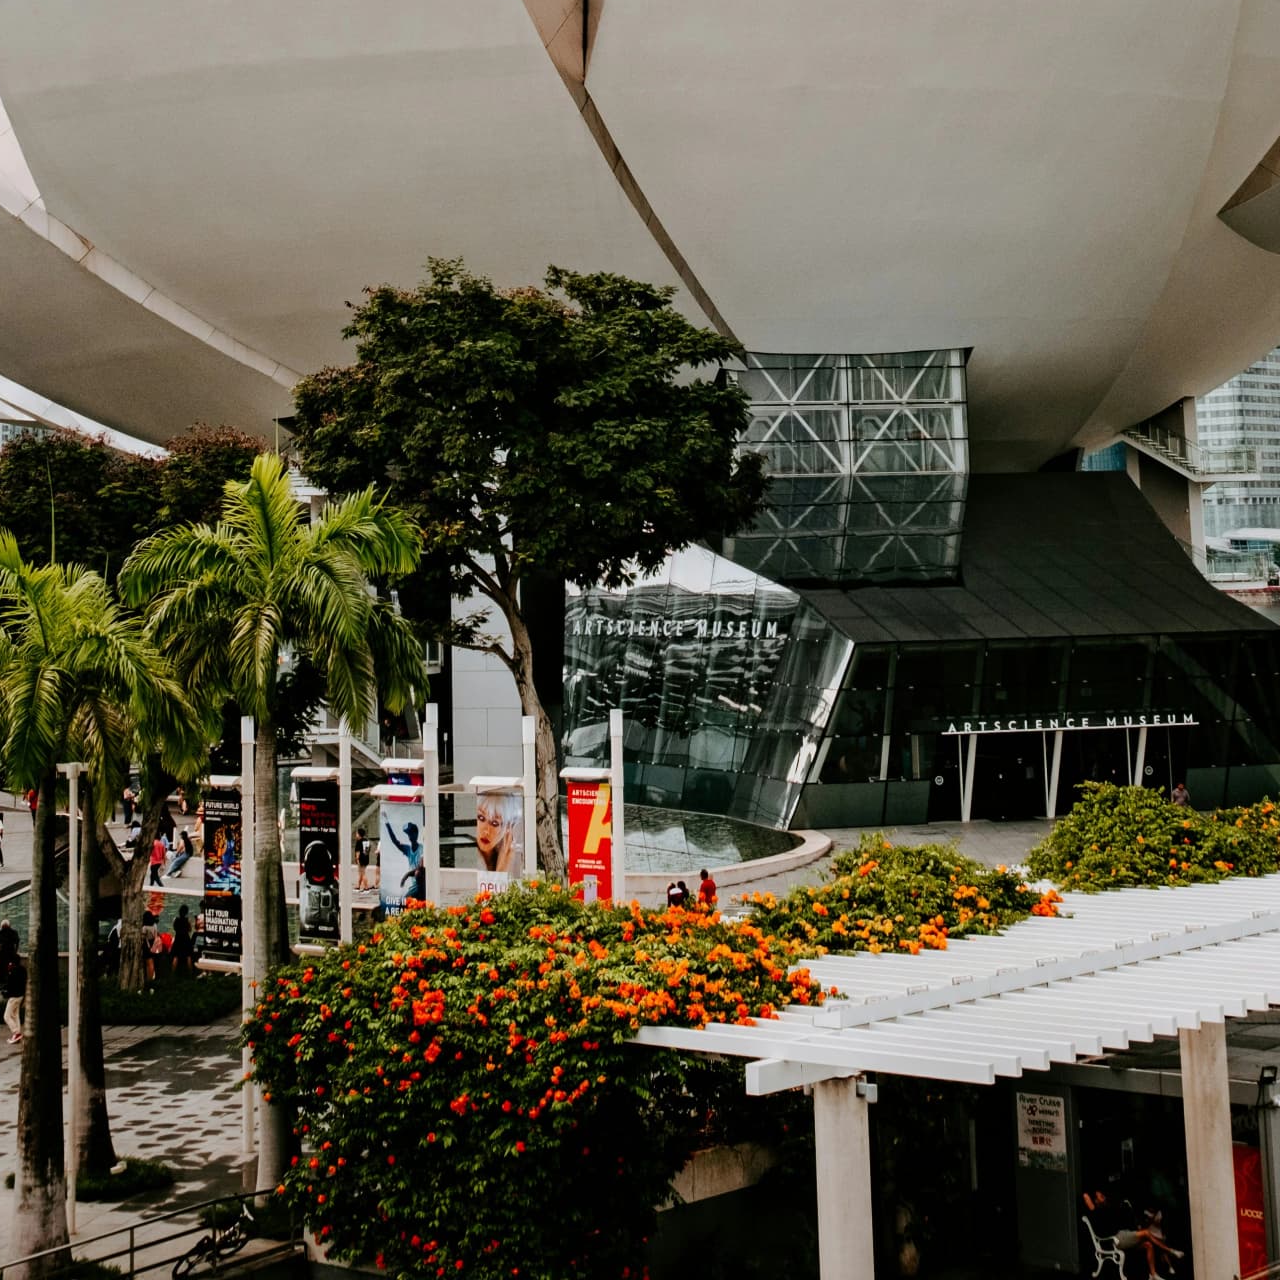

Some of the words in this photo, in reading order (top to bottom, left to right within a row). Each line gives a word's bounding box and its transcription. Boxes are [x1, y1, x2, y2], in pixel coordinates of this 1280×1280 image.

[572, 620, 684, 637] ARTSCIENCE
[694, 619, 778, 639] MUSEUM
[948, 717, 1090, 734] ARTSCIENCE
[1106, 713, 1194, 728] MUSEUM
[205, 801, 222, 809] FUTURE
[223, 802, 239, 810] WORLD
[205, 917, 239, 926] IMAGINATION
[205, 924, 218, 932] TAKE
[218, 925, 238, 935] FLIGHT
[1039, 1096, 1062, 1107] Cruise
